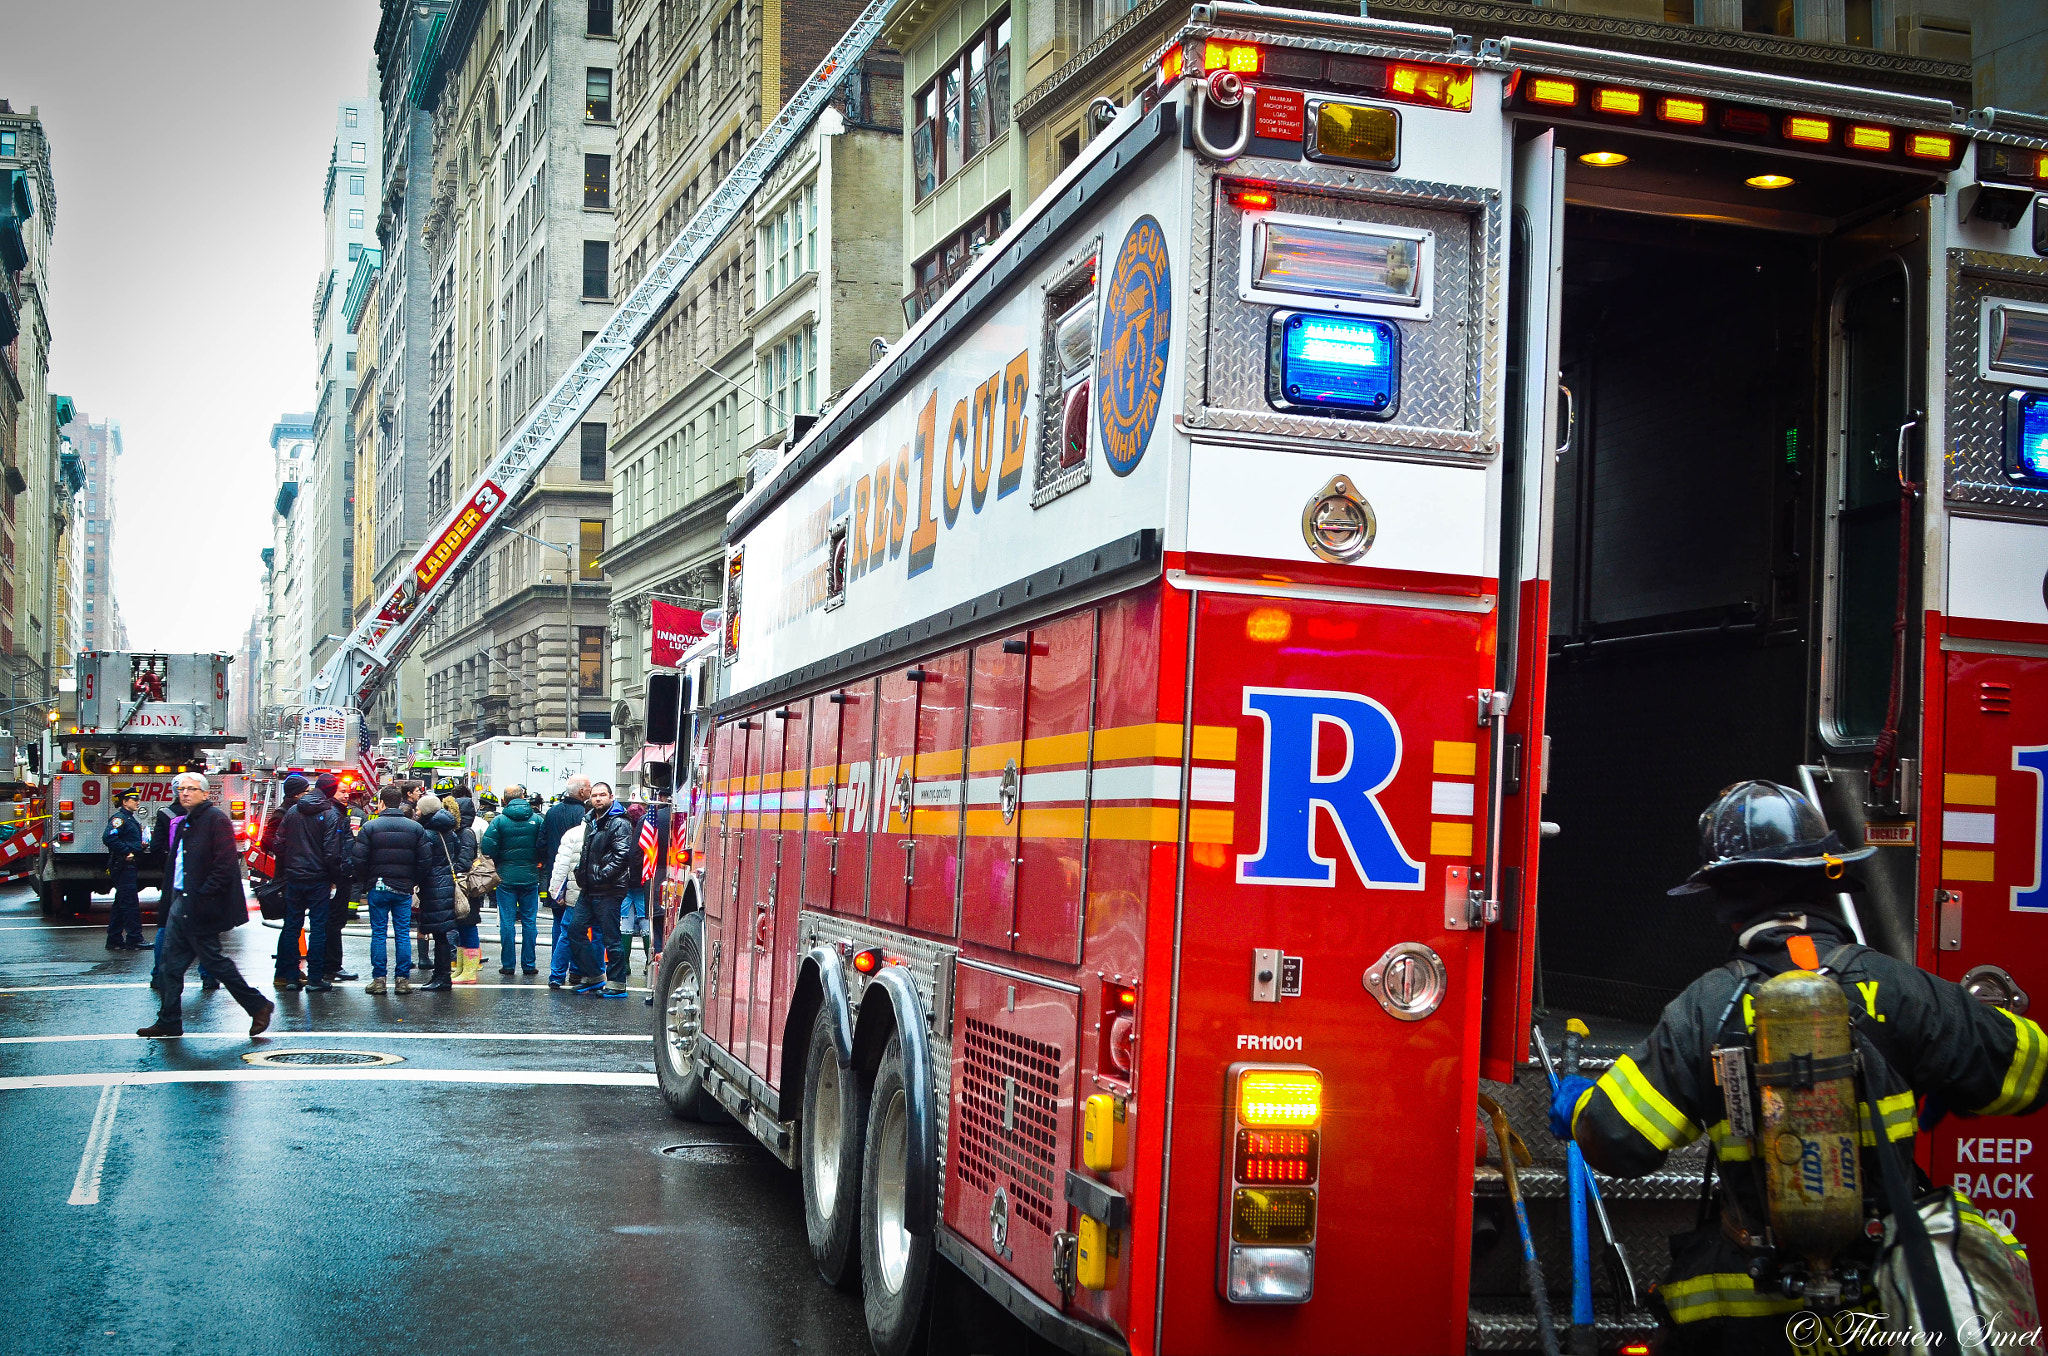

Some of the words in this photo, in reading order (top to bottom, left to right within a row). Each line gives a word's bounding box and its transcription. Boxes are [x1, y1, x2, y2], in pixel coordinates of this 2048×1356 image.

[1263, 102, 1283, 110] ANCHOR
[1110, 224, 1166, 316] RESCUE
[1101, 356, 1162, 463] MANHATTAN
[417, 507, 482, 584] LADDER
[475, 486, 500, 514] 3
[86, 673, 94, 699] 9
[216, 672, 223, 700] 9
[531, 765, 550, 773] FedEx
[81, 780, 101, 806] 9
[842, 756, 902, 833] FDNY
[1236, 686, 1426, 891] R
[1870, 828, 1898, 840] BUCKLE
[1899, 828, 1909, 840] UP
[1236, 1034, 1303, 1051] FR11001
[1839, 1136, 1856, 1191] SCOTT
[1956, 1137, 2033, 1163] KEEP
[1800, 1138, 1824, 1196] SCOTT
[1953, 1173, 2034, 1199] BACK
